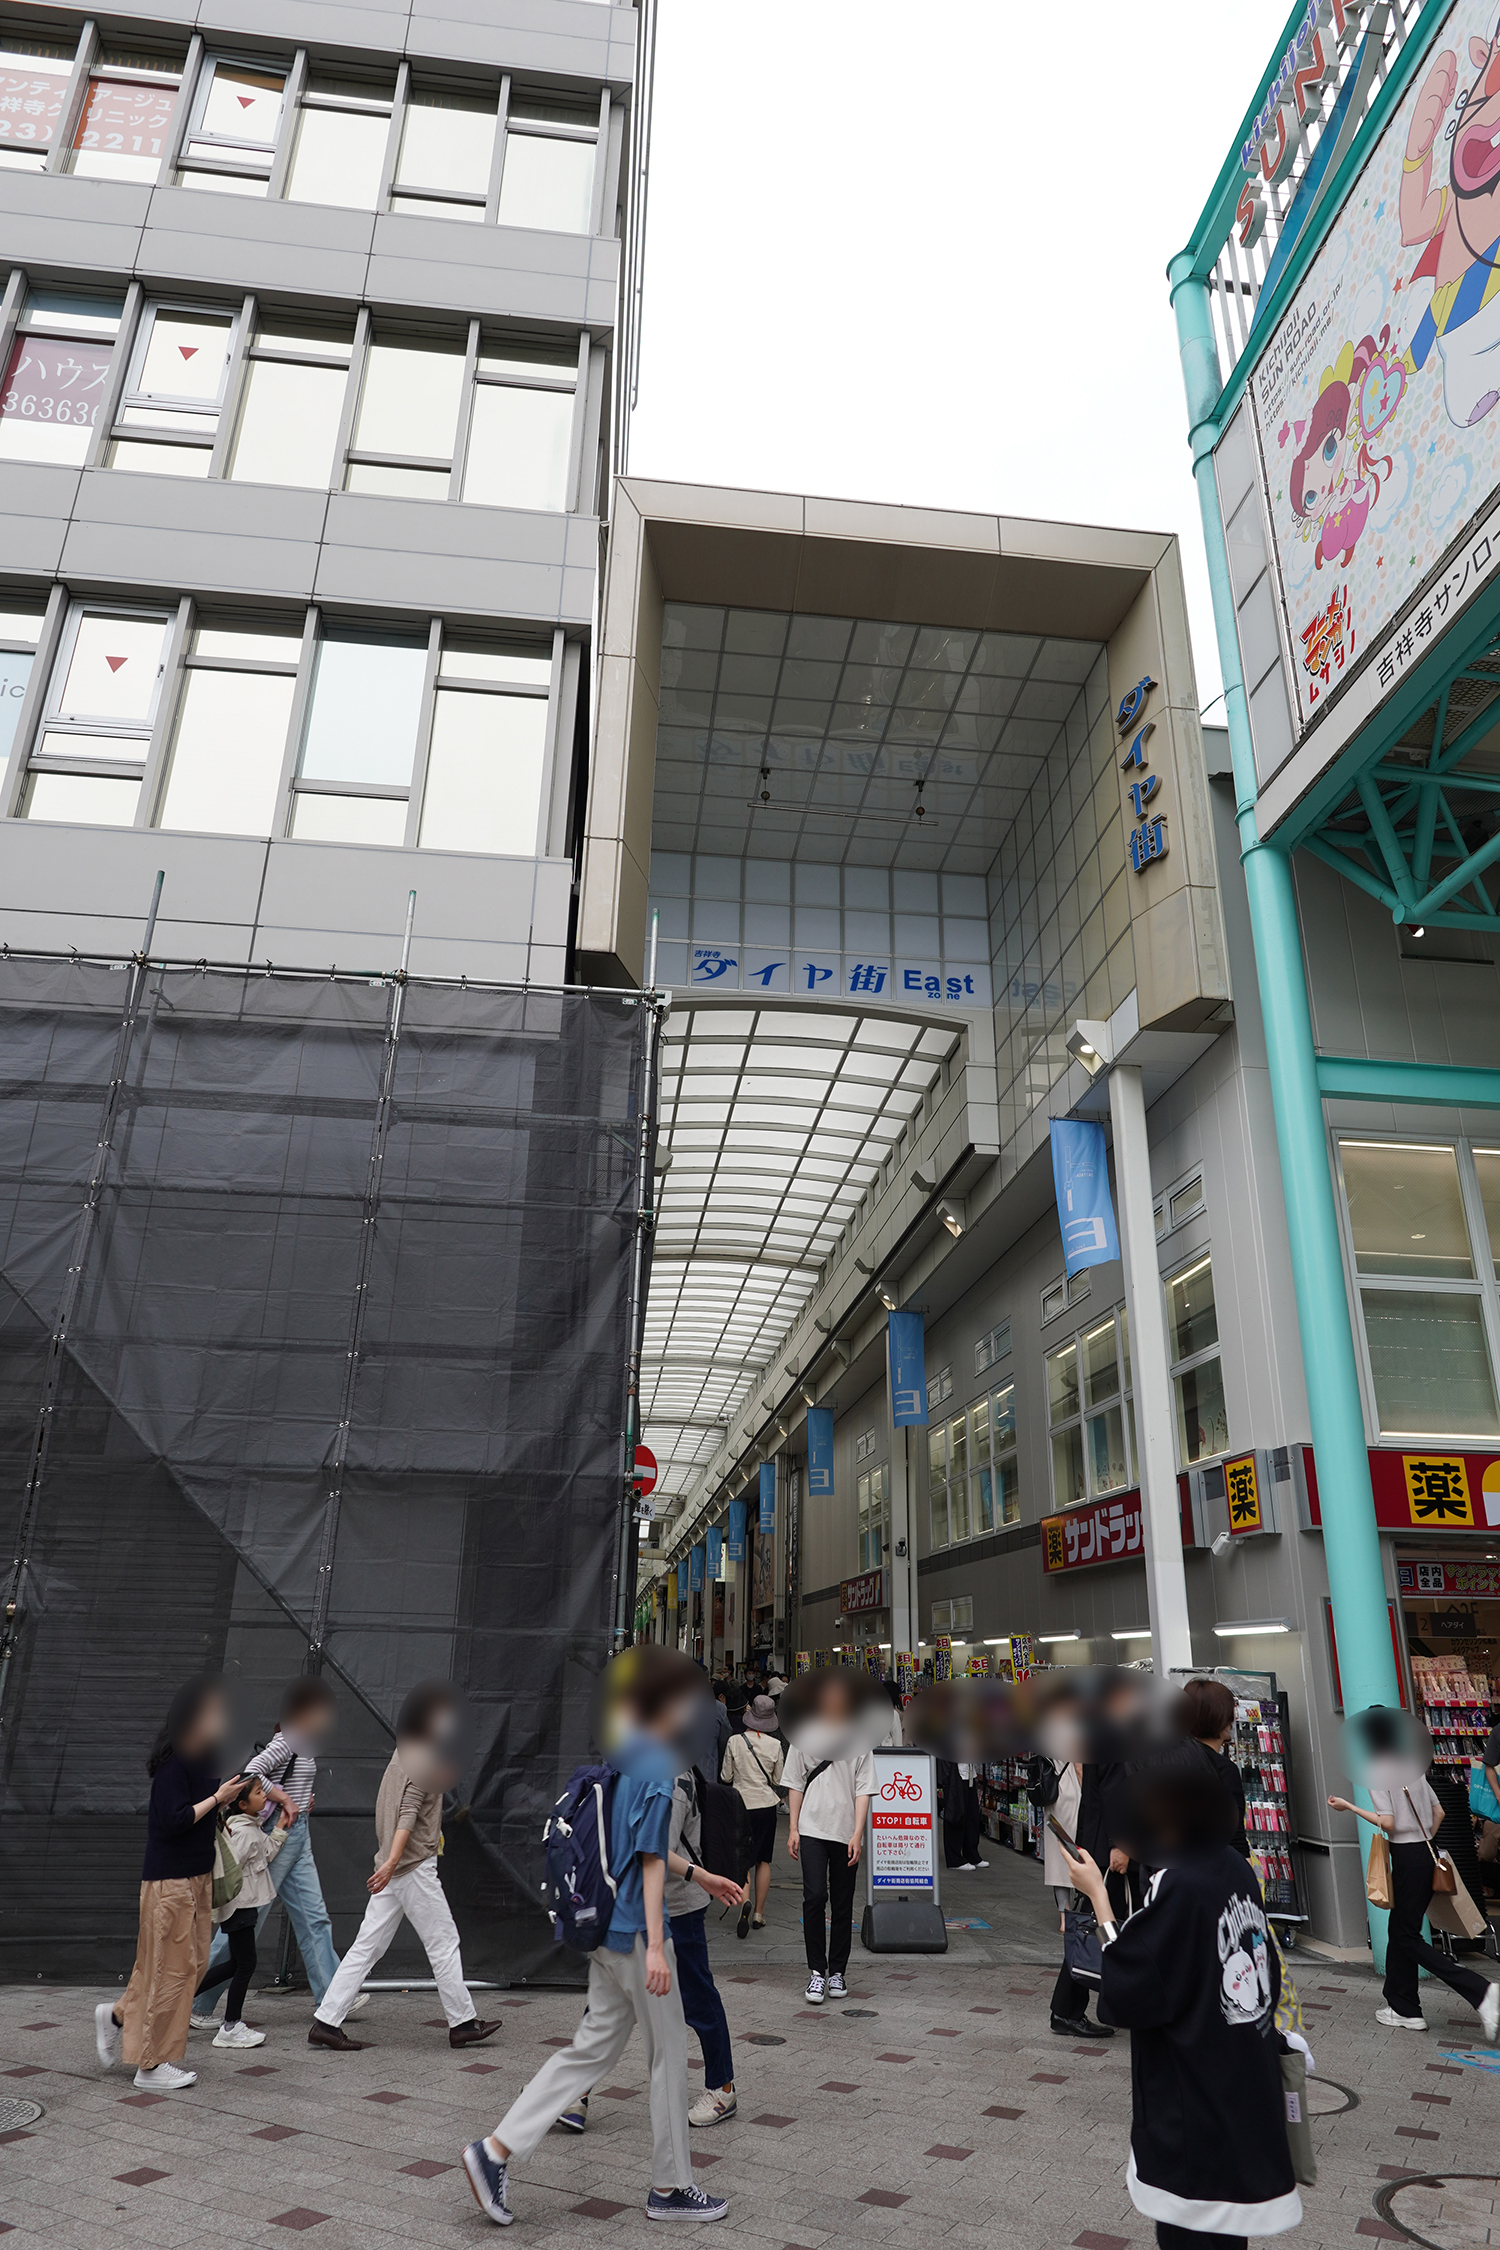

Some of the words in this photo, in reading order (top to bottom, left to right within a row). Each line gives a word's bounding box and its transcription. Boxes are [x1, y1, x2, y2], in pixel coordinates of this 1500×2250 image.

[91, 88, 172, 111] アージュ
[87, 107, 168, 129] リニック
[80, 131, 162, 154] 2211
[1258, 308, 1300, 388] Kichijoji
[1261, 361, 1284, 405] SUN
[1284, 301, 1317, 363] ROAD
[1114, 676, 1168, 873] ダイヤ街
[694, 949, 722, 958] 吉祥寺
[692, 958, 889, 994] ダイヤ街
[903, 969, 975, 995] East
[927, 991, 961, 1001] zone
[1229, 1465, 1257, 1522] 薬
[1409, 1462, 1468, 1519] 薬
[1047, 1526, 1063, 1565] 薬
[1064, 1504, 1145, 1563] サンドラッ
[1419, 1566, 1442, 1577] 店内
[1446, 1564, 1500, 1578] サンドラッ
[1420, 1577, 1443, 1588] 全品
[1456, 1578, 1499, 1591] ポイント
[1420, 1618, 1428, 1631] 2
[876, 1816, 902, 1825] STOP!
[905, 1816, 928, 1826] 自転車
